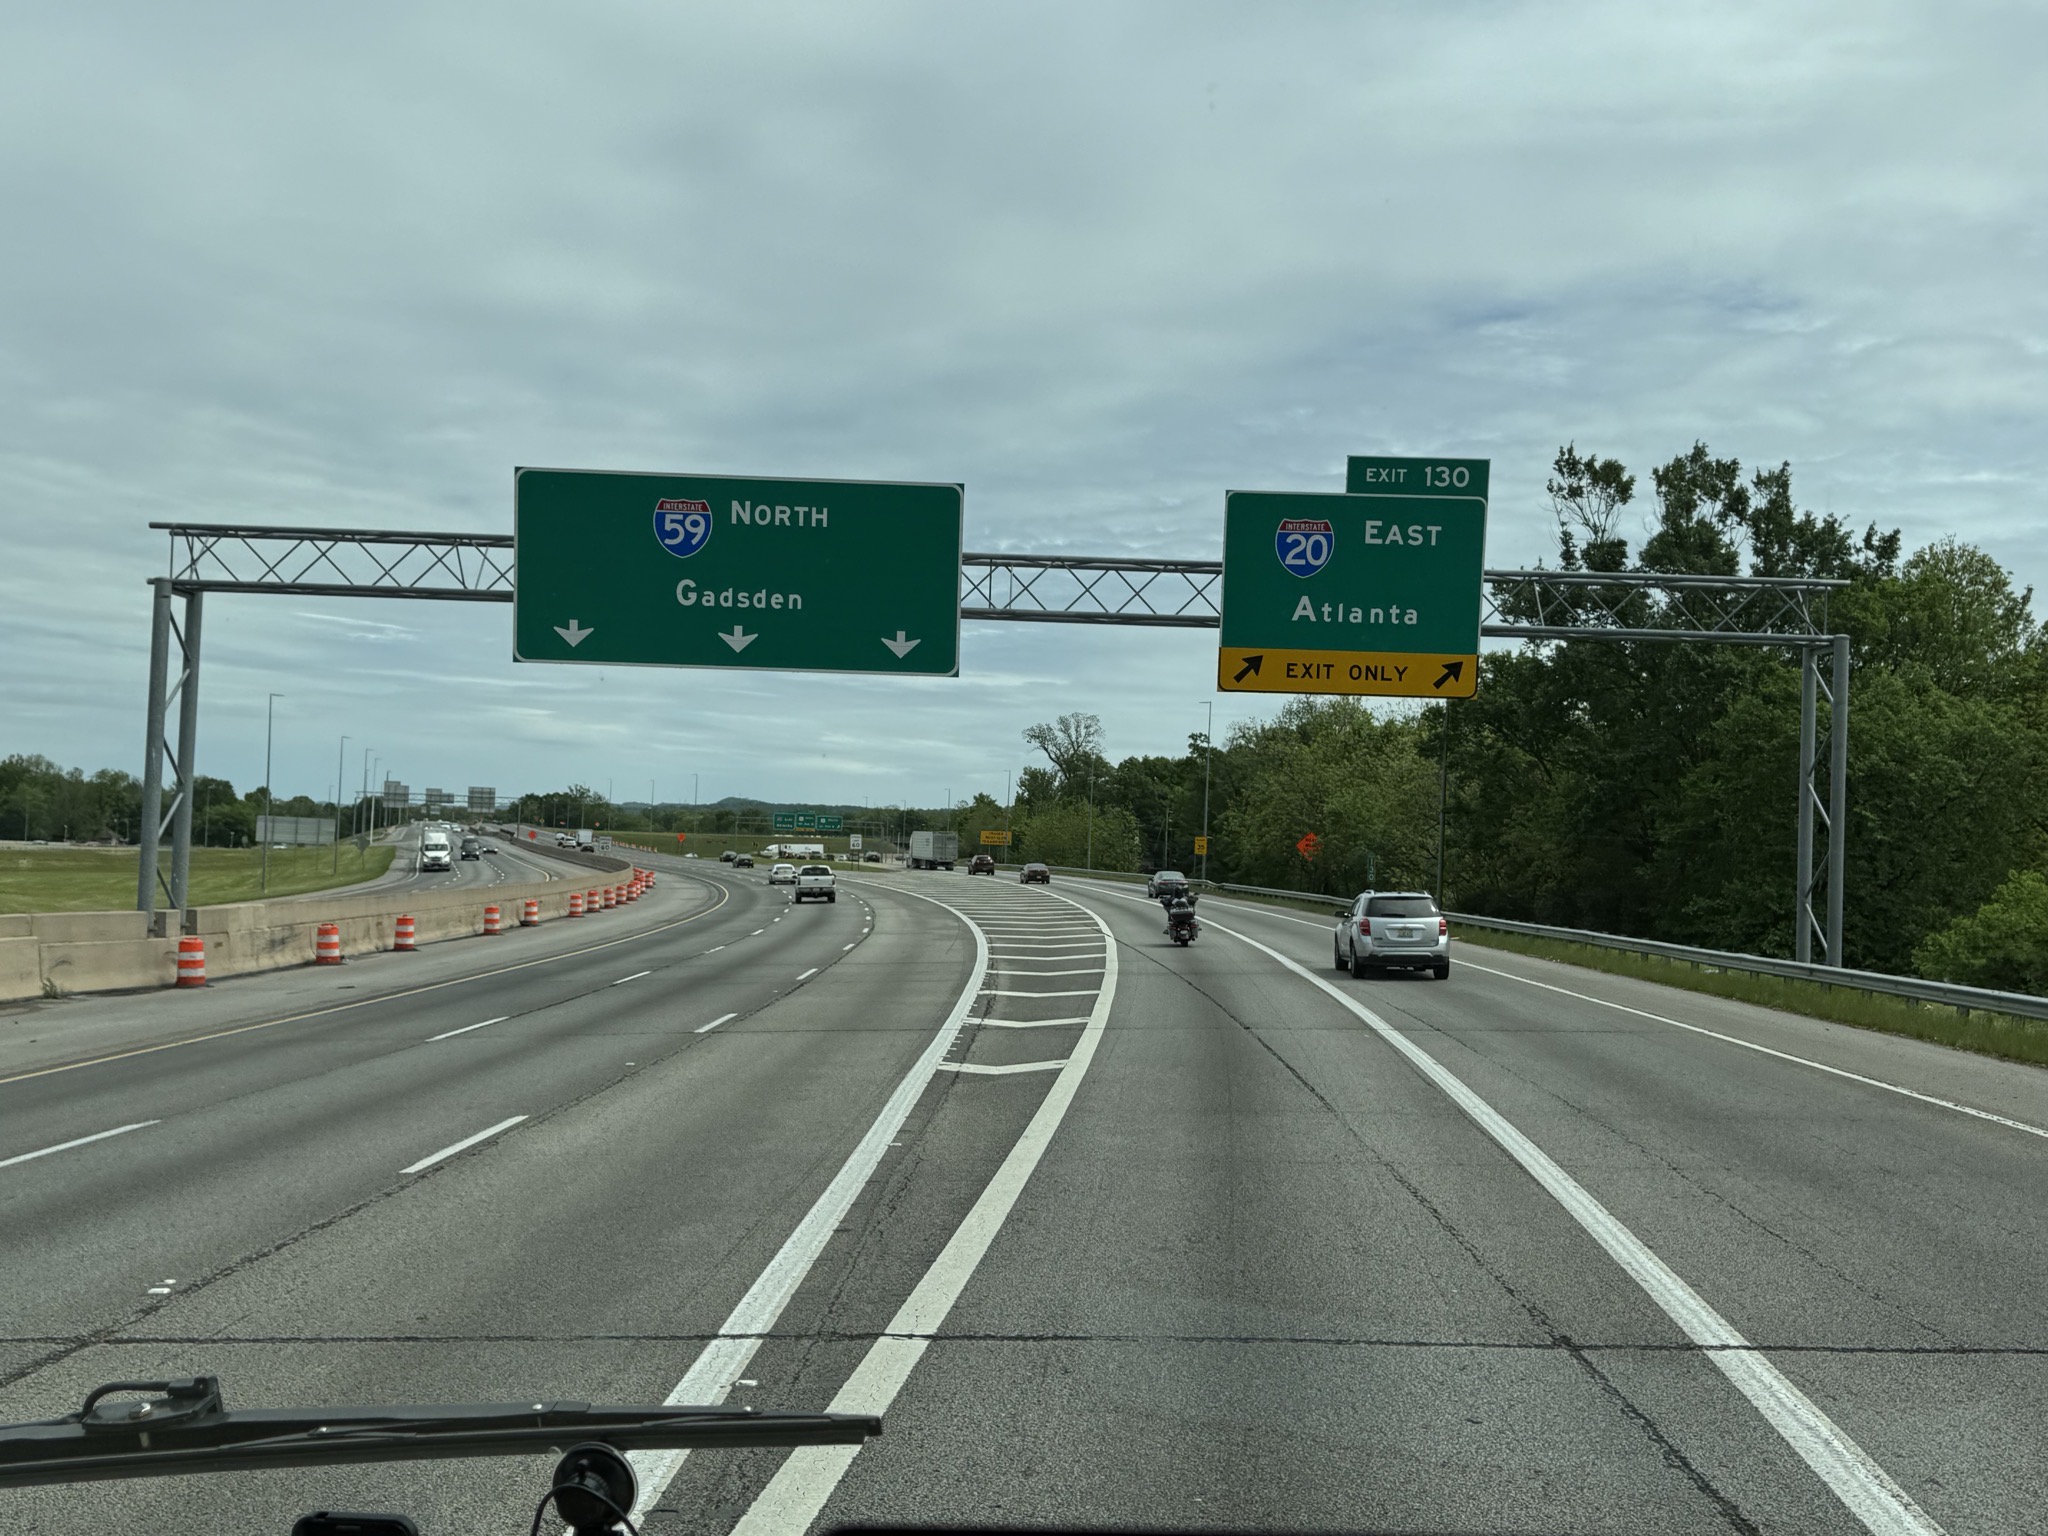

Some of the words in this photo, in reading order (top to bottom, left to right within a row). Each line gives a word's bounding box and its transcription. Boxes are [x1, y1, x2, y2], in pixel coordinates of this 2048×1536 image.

[1366, 467, 1408, 483] EXIT
[1424, 466, 1470, 488] 130
[663, 502, 704, 512] INTERSTATE
[730, 500, 828, 528] NORTH
[663, 513, 706, 546] 59
[1285, 522, 1326, 532] INTERSTATE
[1364, 520, 1442, 547] EAST
[1284, 533, 1329, 566] 20
[676, 578, 803, 609] Gadsden
[1291, 595, 1418, 625] Atlanta
[1286, 662, 1335, 680] EXIT
[1348, 664, 1409, 682] ONLY
